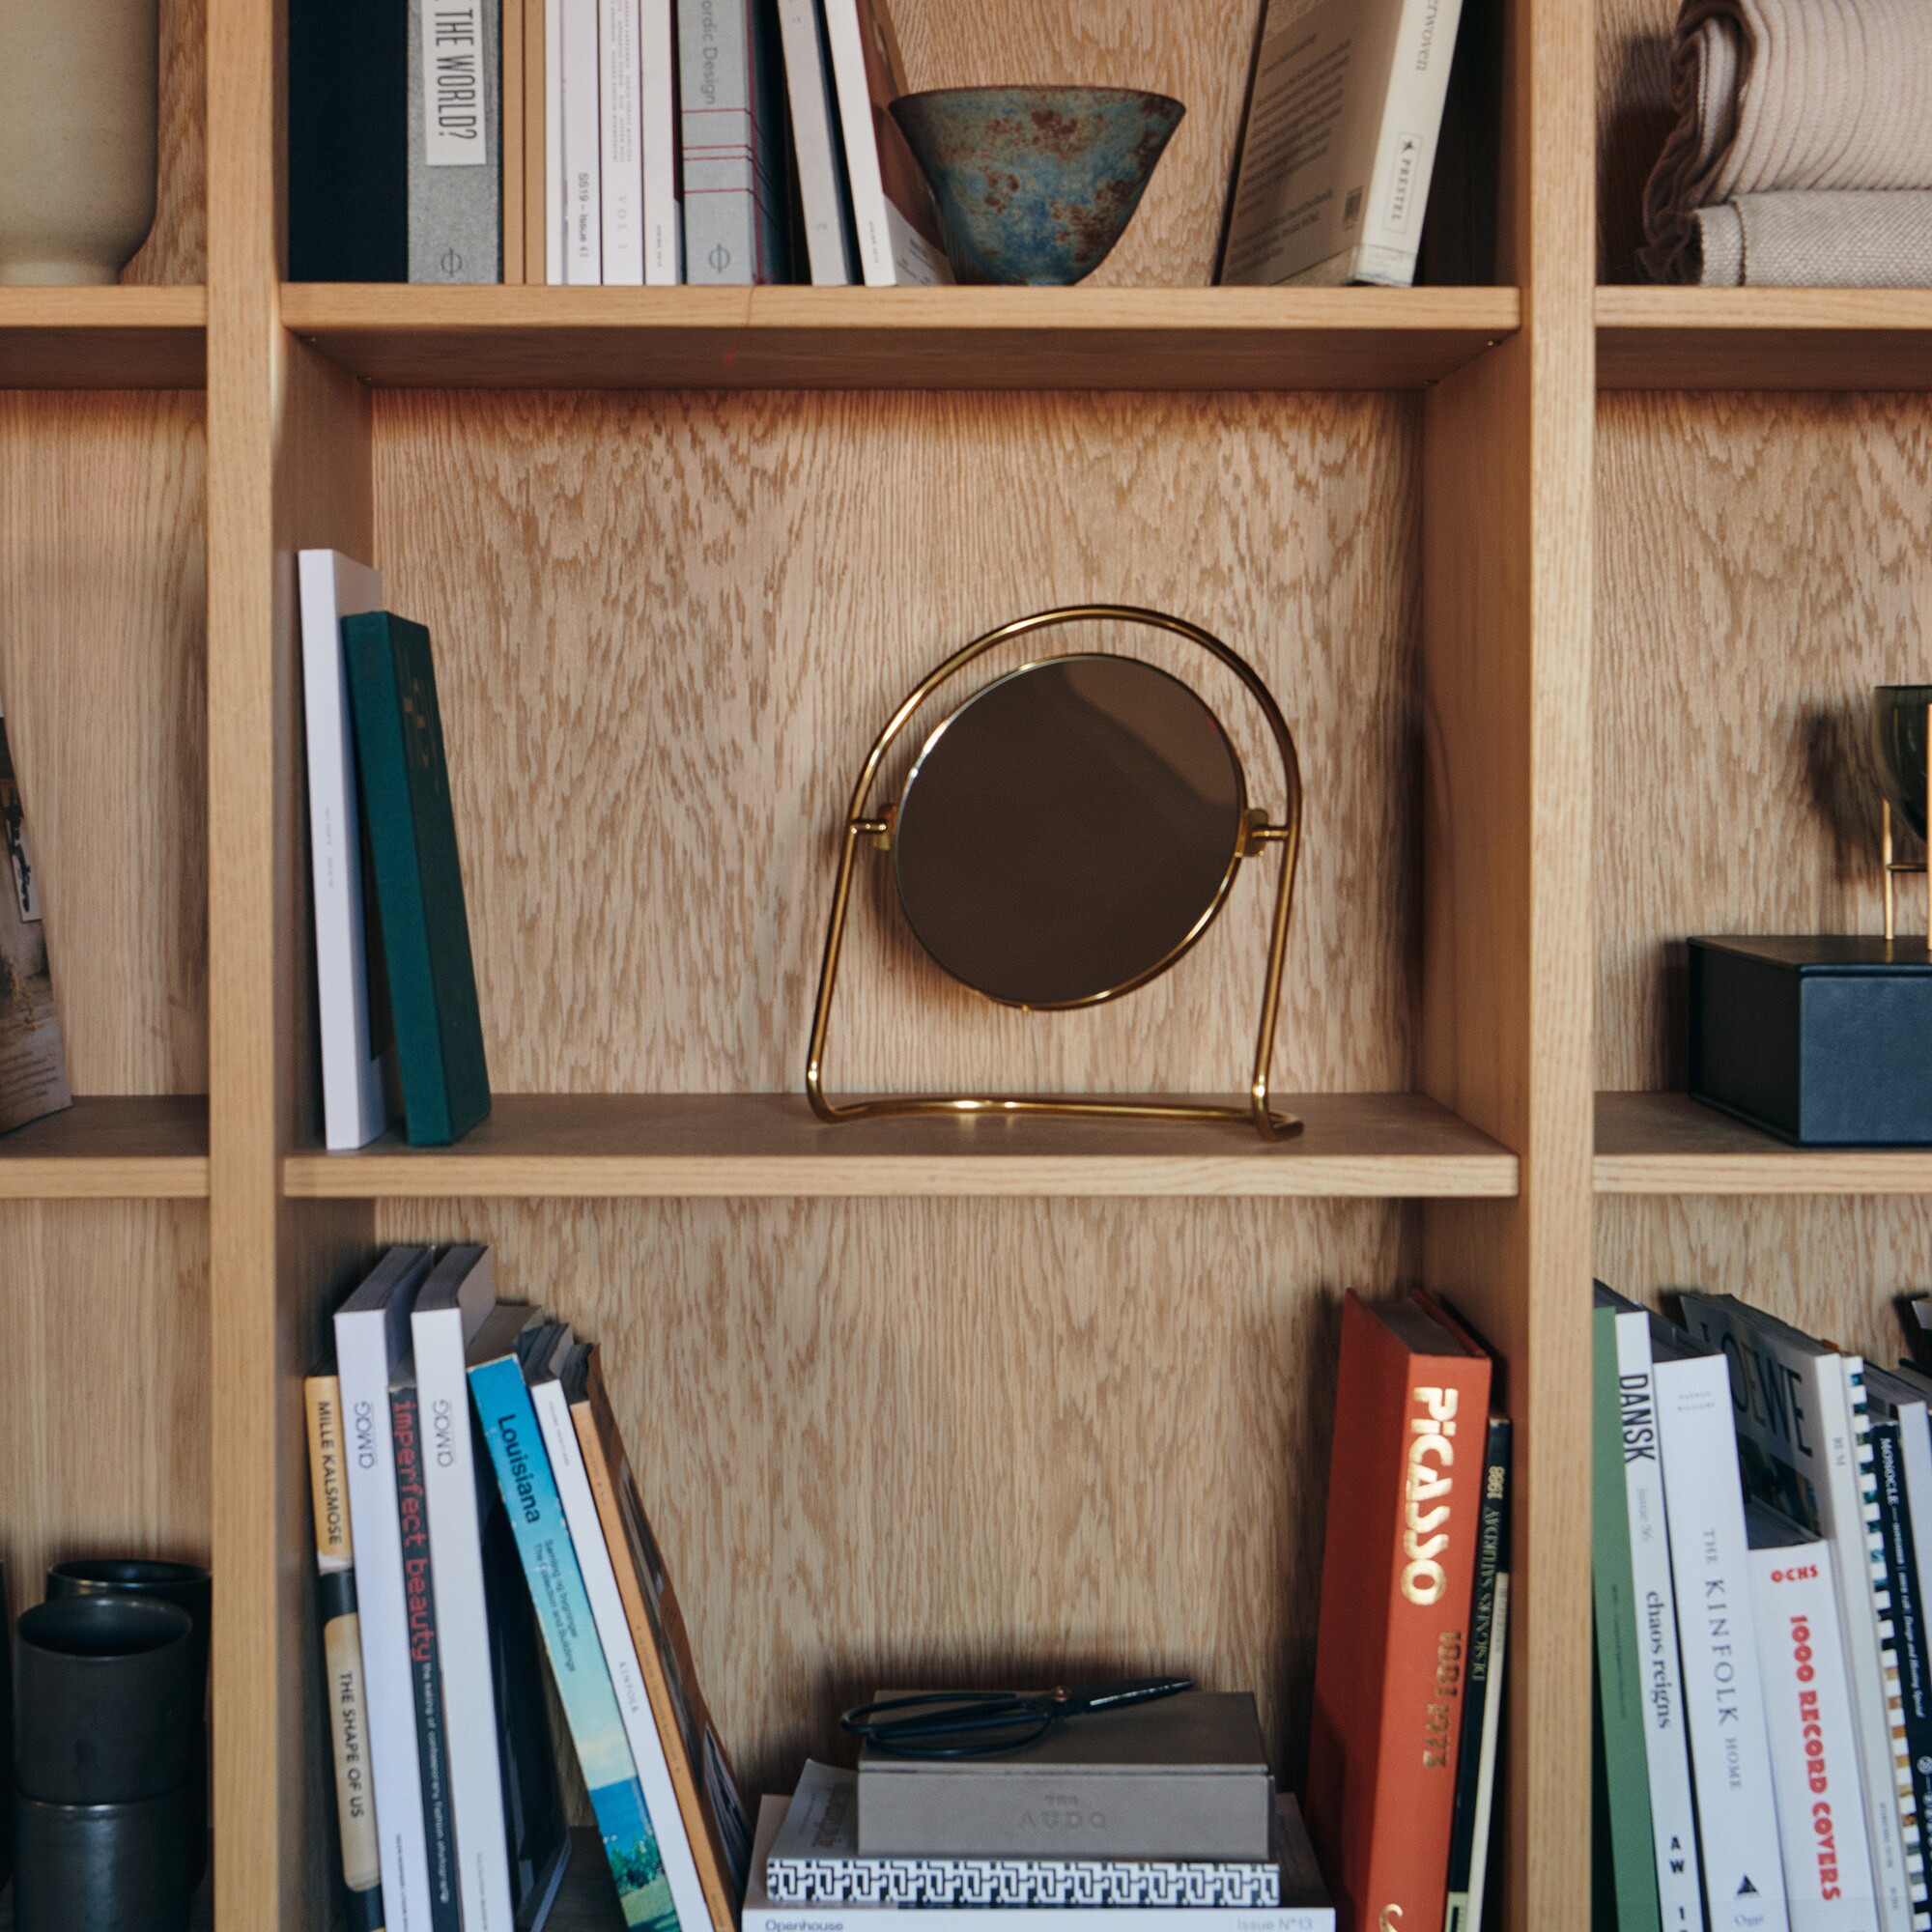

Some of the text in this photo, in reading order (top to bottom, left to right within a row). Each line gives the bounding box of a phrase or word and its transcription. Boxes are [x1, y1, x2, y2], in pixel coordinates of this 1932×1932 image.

[435, 10, 477, 140] THE WORLD?
[700, 46, 719, 104] Design
[1391, 158, 1411, 221] PRESTEL
[497, 1413, 542, 1525] Louisiana
[1617, 1372, 1657, 1465] DANSK
[1880, 1436, 1899, 1506] MONOCLE
[317, 1401, 342, 1546] MILLE KALSMOSE
[390, 1401, 431, 1548] imperfect
[404, 1557, 436, 1663] beauty
[1769, 1564, 1820, 1585] OCHS
[1644, 1590, 1672, 1730] chaos reigns
[1702, 1528, 1743, 1792] THE KINFOLK HOME
[339, 1672, 365, 1819] THE SHAPE OF US
[1788, 1613, 1841, 1903] 1000 RECORD COVERS
[1016, 1810, 1109, 1831] AUDO
[764, 1918, 844, 1932] Openhouse
